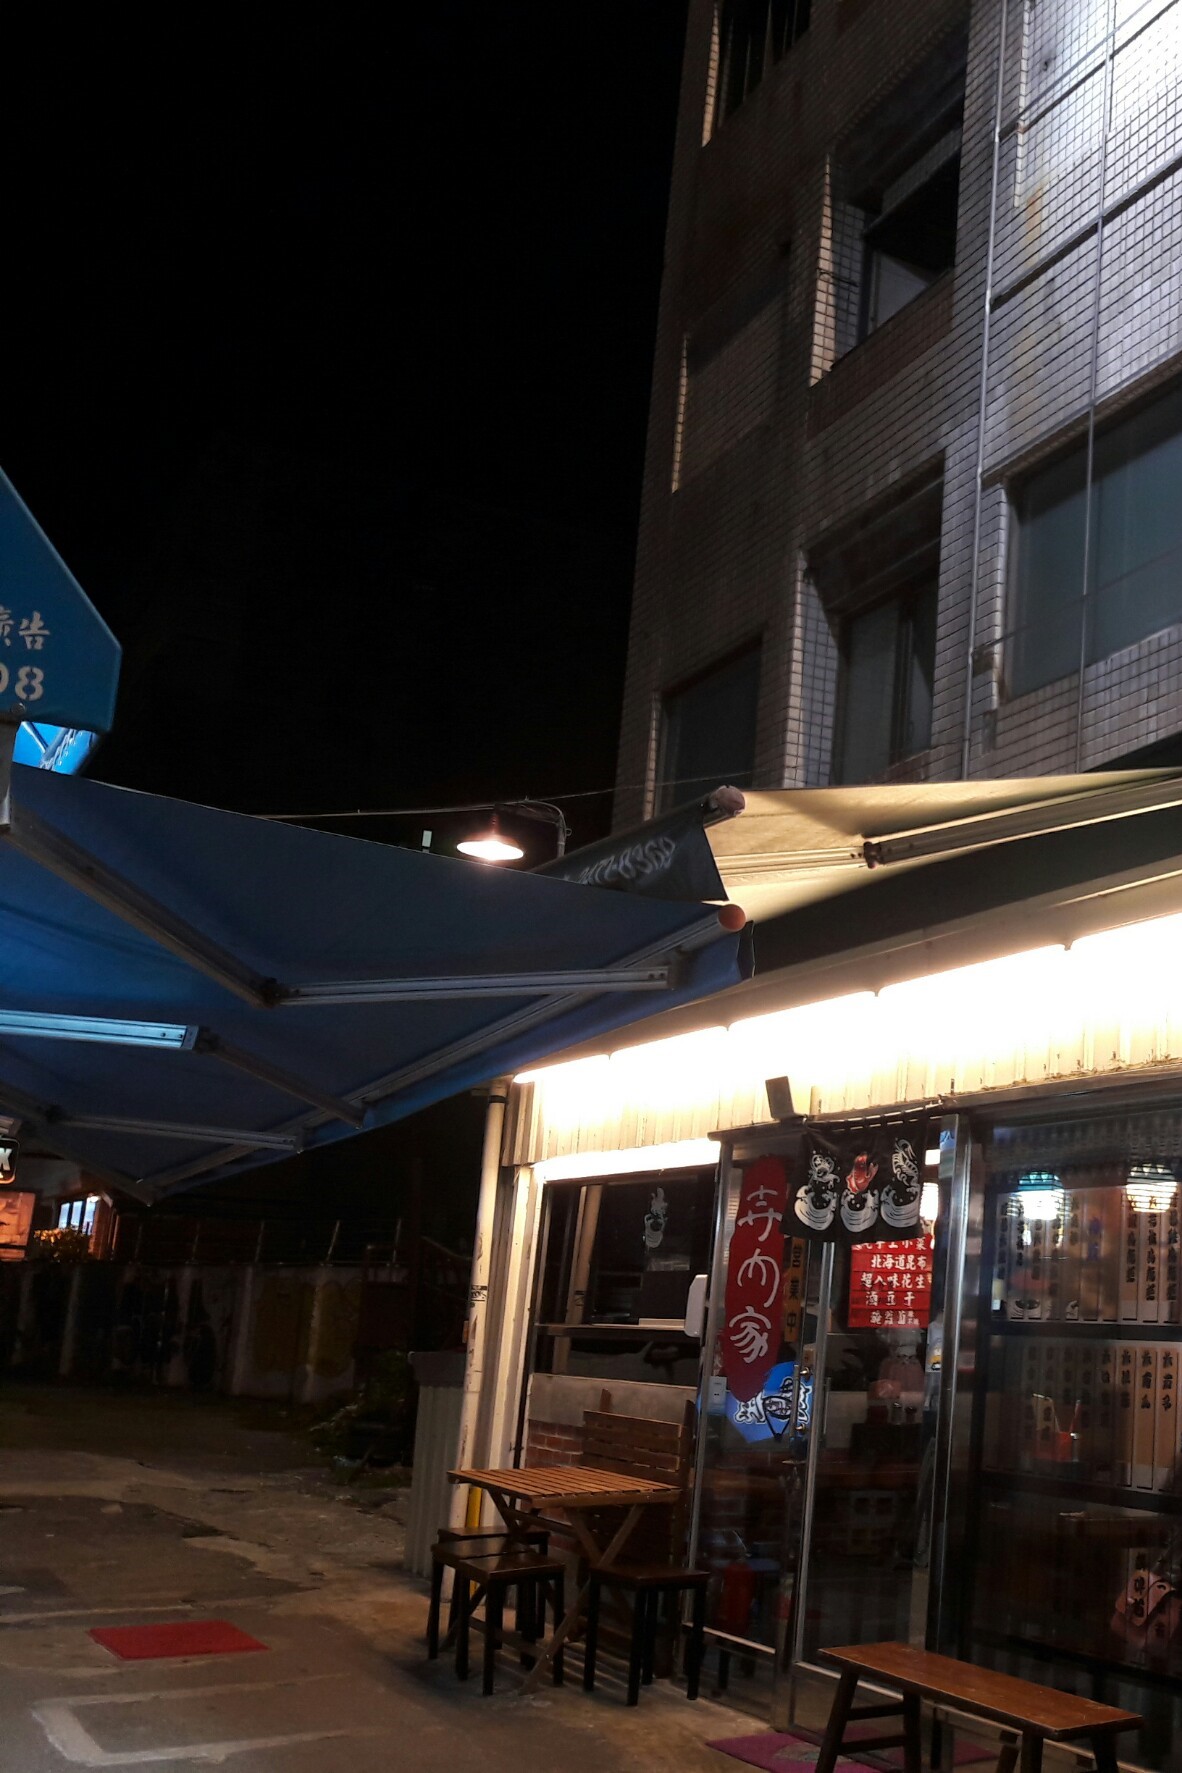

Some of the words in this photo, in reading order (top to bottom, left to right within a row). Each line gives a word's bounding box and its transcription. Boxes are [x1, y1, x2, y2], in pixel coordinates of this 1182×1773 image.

[870, 1254, 927, 1270] 北海道昆布
[861, 1272, 926, 1289] 超入味花生
